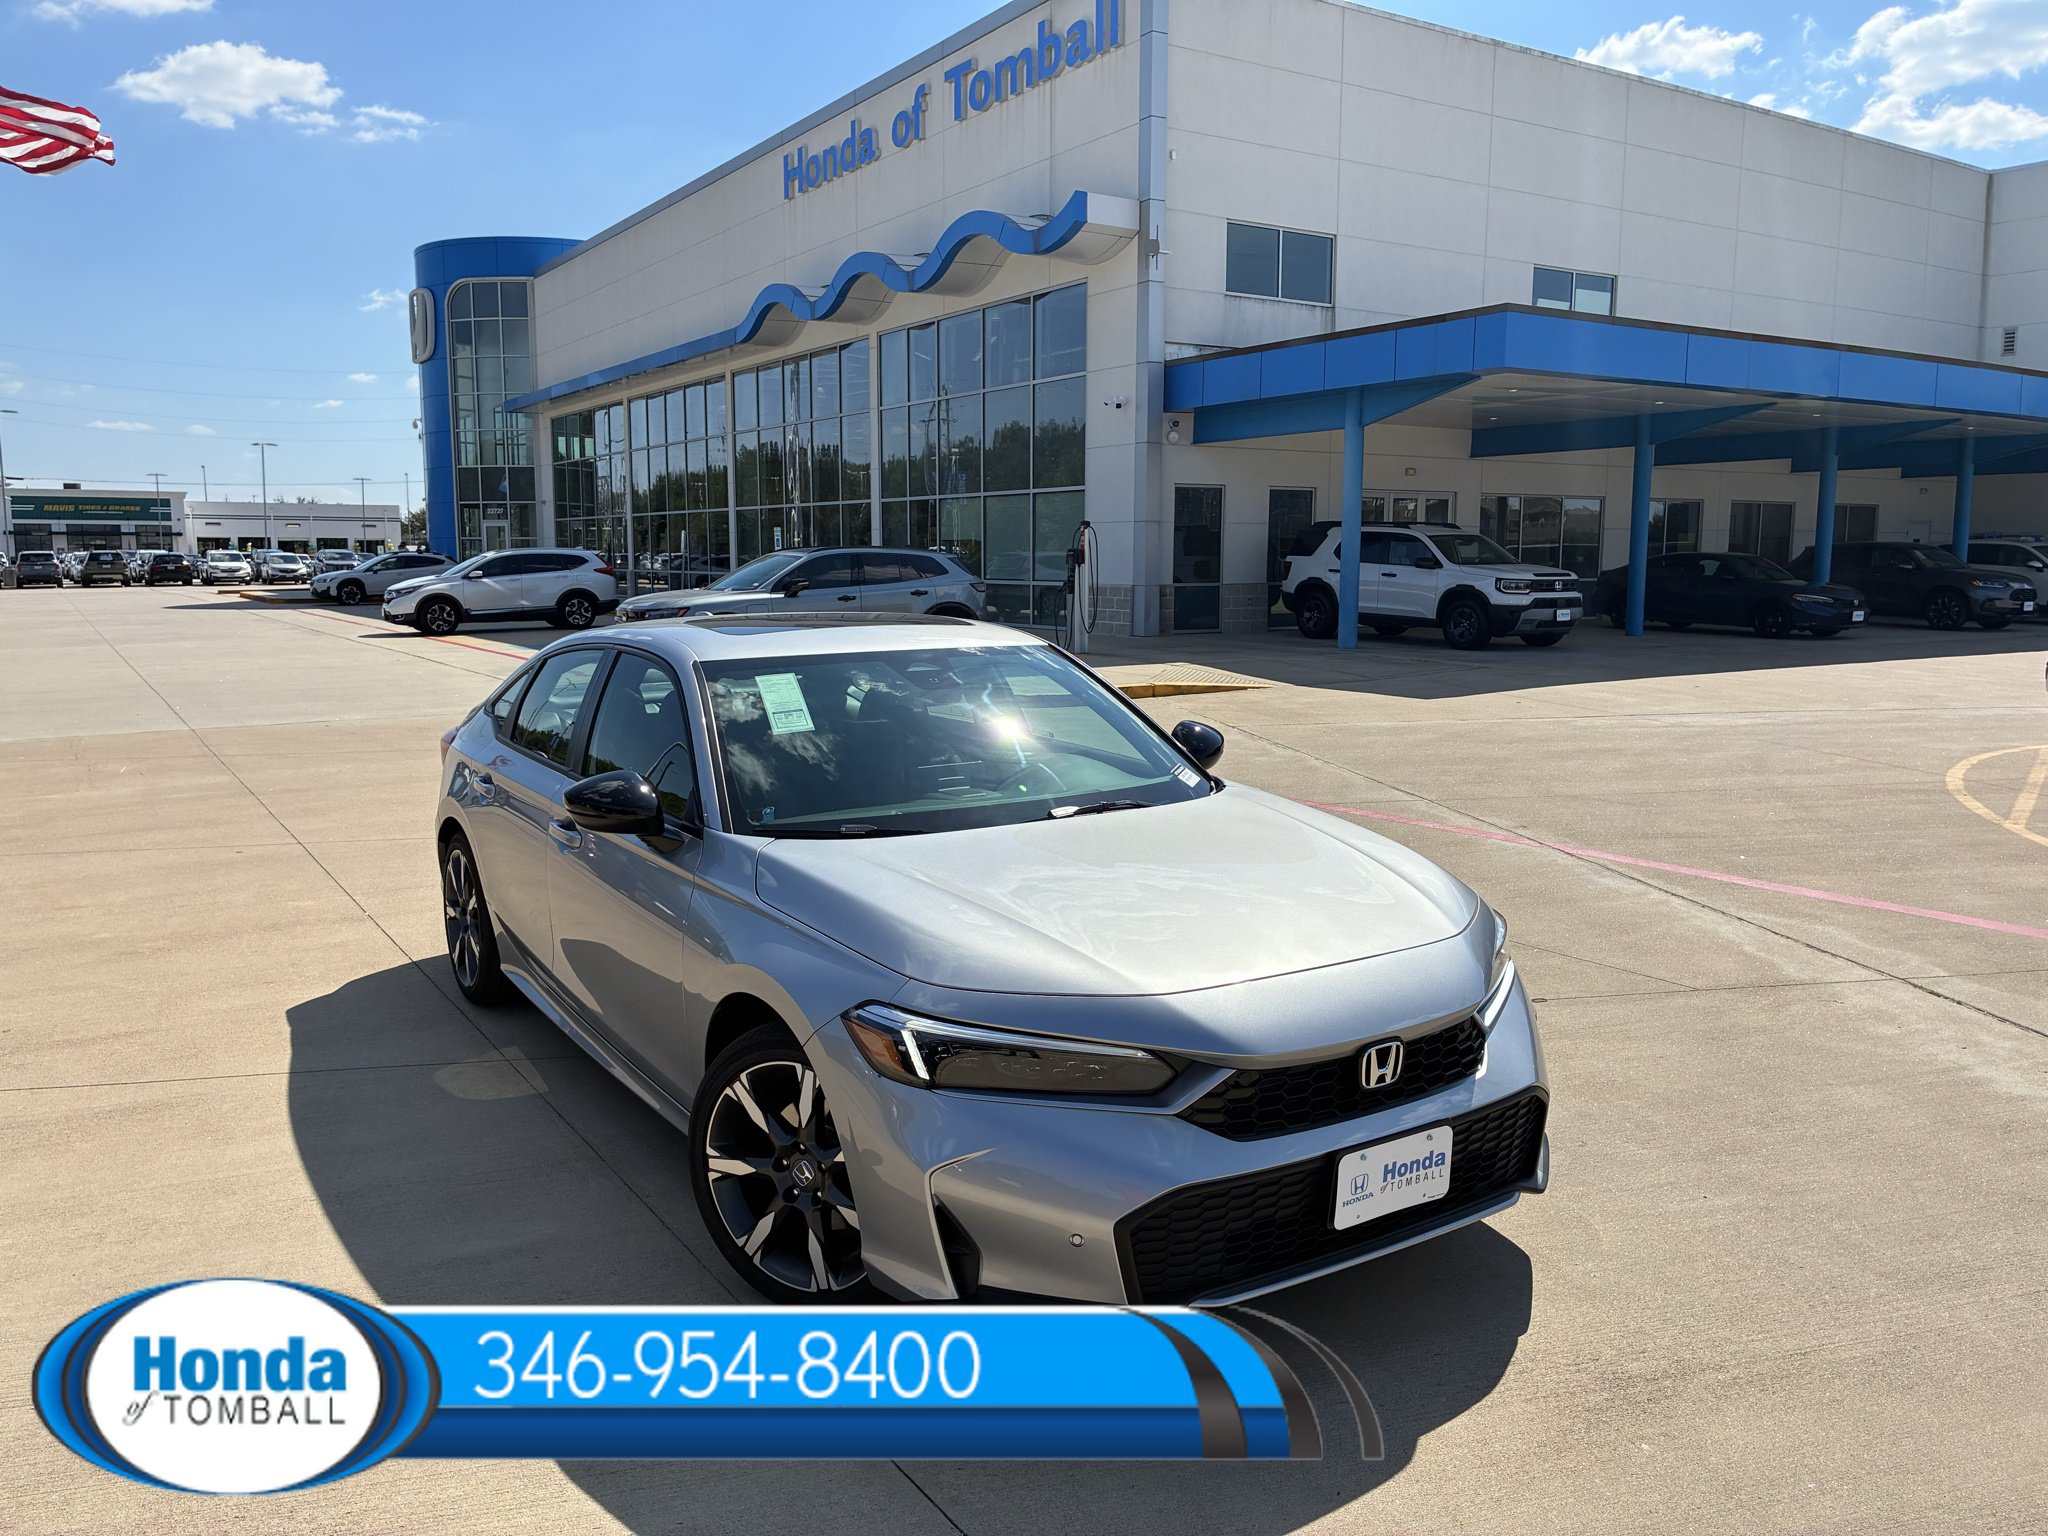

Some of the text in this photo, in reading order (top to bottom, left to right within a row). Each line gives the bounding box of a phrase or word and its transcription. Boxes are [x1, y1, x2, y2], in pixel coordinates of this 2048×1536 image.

[783, 0, 1124, 200] Honda of Tomball
[43, 504, 75, 512] MAVIS
[1382, 1150, 1446, 1183] Honda
[1380, 1168, 1444, 1194] of TOMBALL
[1342, 1192, 1374, 1208] HONDA
